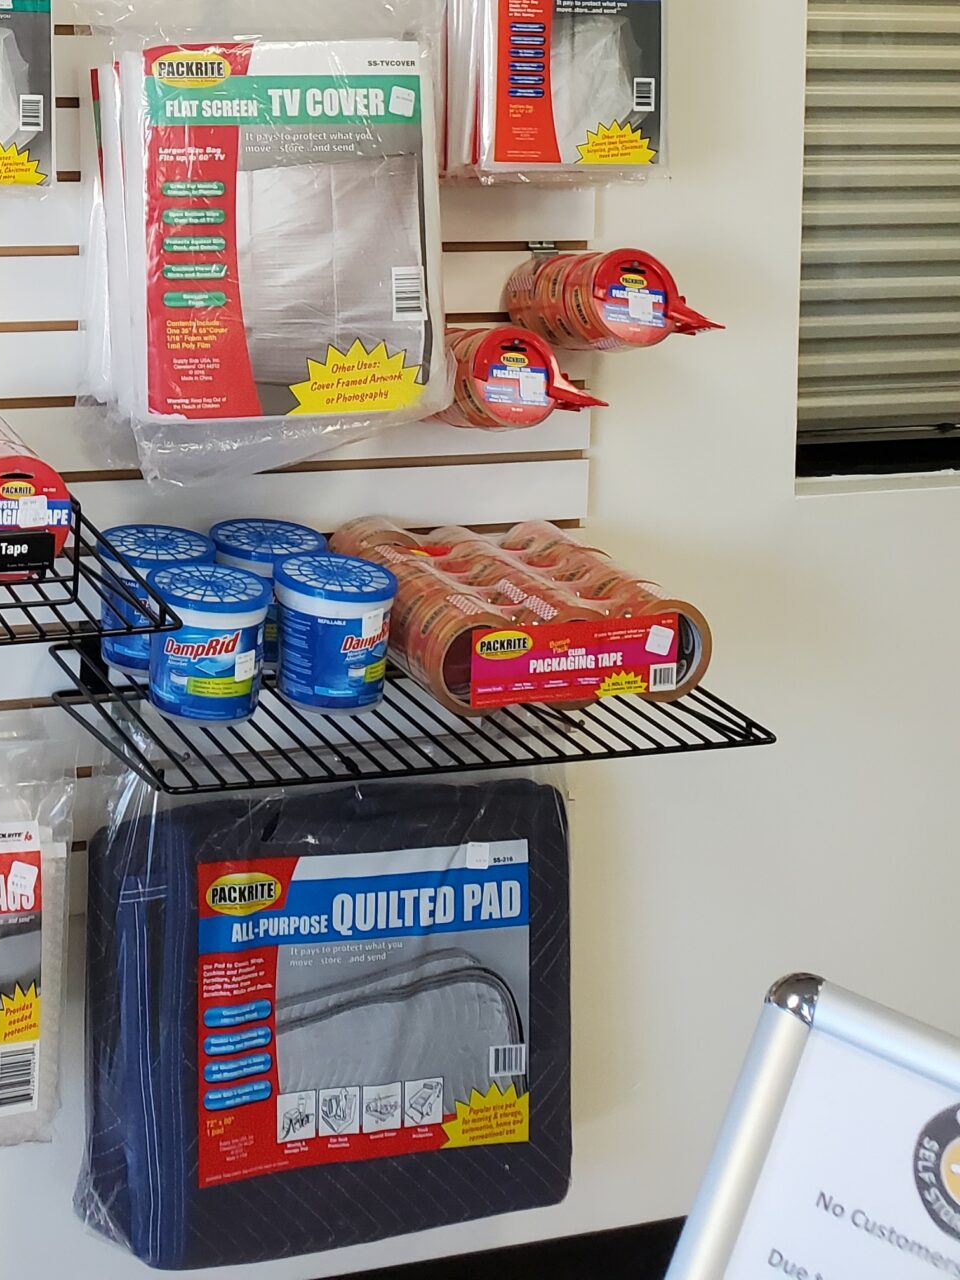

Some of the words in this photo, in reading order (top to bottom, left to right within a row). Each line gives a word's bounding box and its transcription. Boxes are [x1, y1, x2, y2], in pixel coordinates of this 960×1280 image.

[158, 61, 224, 77] PACKRITE
[165, 99, 198, 117] FLAT
[202, 99, 258, 117] SCREEN
[268, 88, 300, 116] TV
[305, 87, 385, 117] COVER
[245, 132, 253, 140] It
[256, 133, 277, 143] pays
[281, 132, 291, 140] to
[292, 132, 326, 143] protect
[330, 131, 353, 140] what
[355, 132, 372, 143] you
[332, 363, 354, 374] Other
[356, 360, 381, 371] Uses:
[310, 381, 335, 392] Cover
[336, 376, 368, 388] Framed
[369, 372, 403, 384] Artwork
[336, 389, 390, 403] Photography
[2, 486, 32, 494] PACKRITE
[0, 542, 28, 557] Tape
[340, 620, 390, 653] Damp
[480, 637, 528, 653] PACKRITE
[164, 629, 242, 662] DampRid
[568, 647, 586, 657] CLEAR
[529, 655, 595, 673] PACKAGING
[597, 652, 623, 668] TAPE
[211, 882, 275, 904] PACKRITE
[231, 914, 328, 943] ALL-PURPOSE
[332, 885, 455, 936] QUILTED
[463, 879, 521, 922] PAD
[300, 945, 320, 957] pays
[321, 945, 331, 954] to
[332, 943, 363, 955] protect
[364, 941, 386, 951] what
[387, 940, 403, 950] you
[5, 1002, 33, 1017] Provides
[8, 1013, 32, 1026] needed
[3, 1022, 39, 1040] protection.
[815, 1190, 846, 1219] No
[767, 1247, 808, 1280] Due
